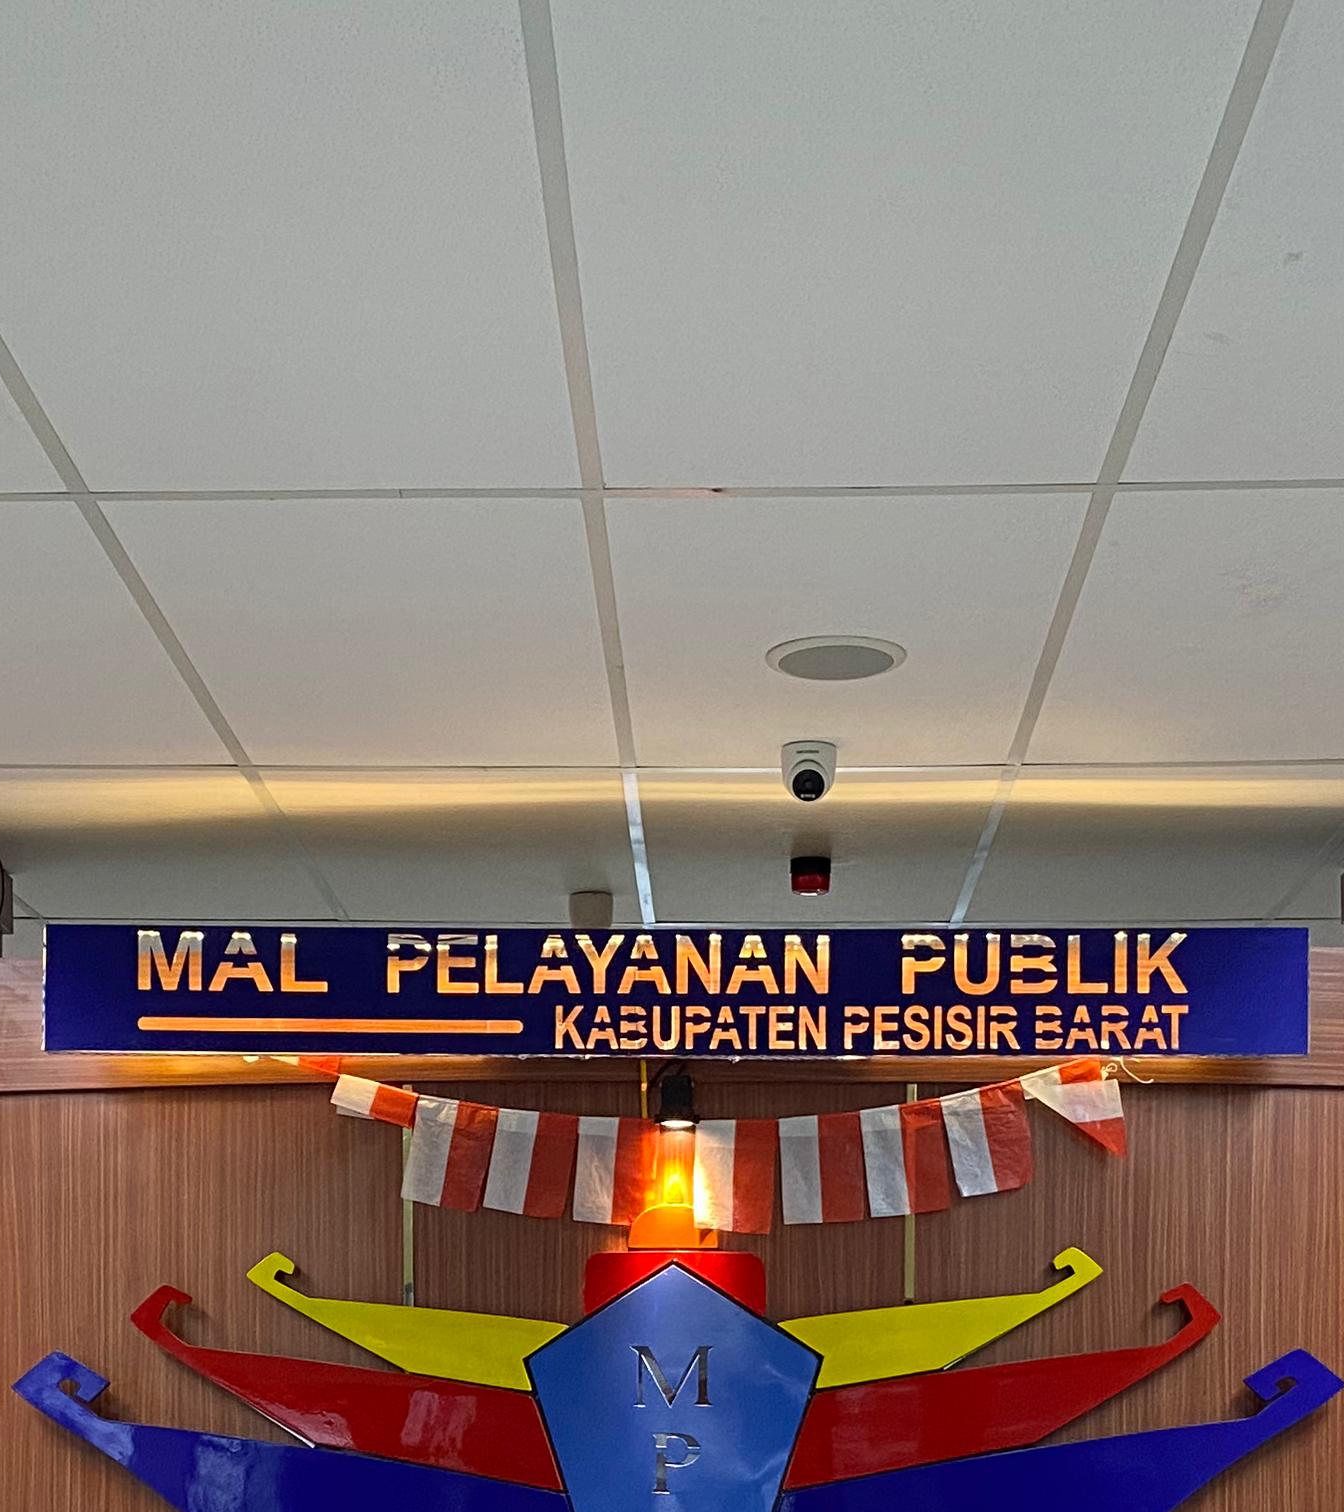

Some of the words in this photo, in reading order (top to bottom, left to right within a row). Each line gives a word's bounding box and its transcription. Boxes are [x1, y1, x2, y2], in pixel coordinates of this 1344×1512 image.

[138, 930, 328, 992] MAL
[387, 933, 830, 995] PELAYANAN
[901, 932, 1187, 995] PUBLIK
[555, 1005, 826, 1050] KABUPATEN
[844, 1005, 1020, 1050] PESISIR
[1035, 1005, 1188, 1049] BARAT
